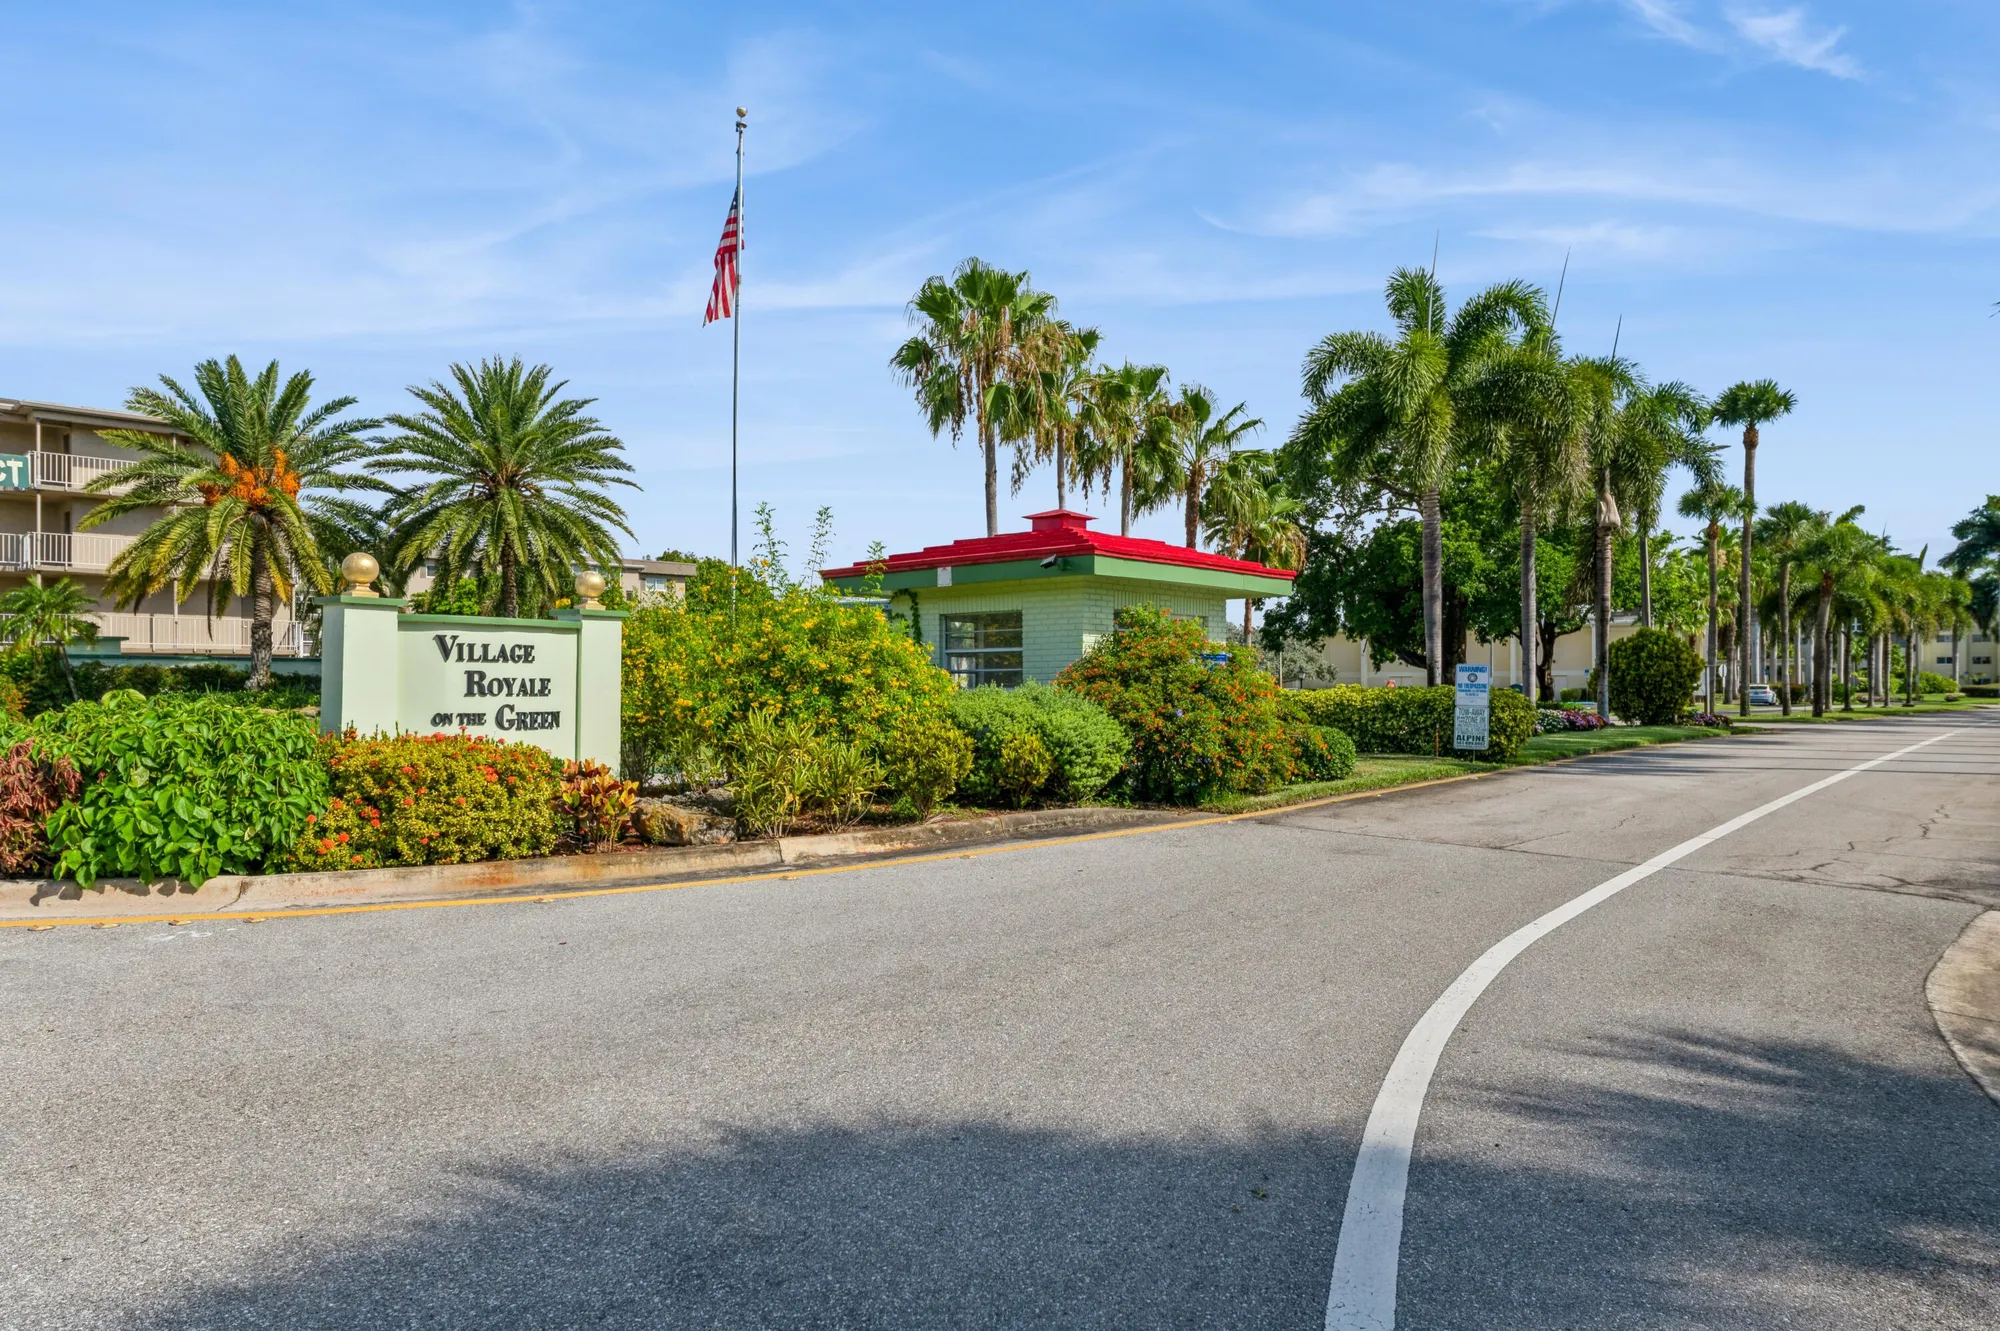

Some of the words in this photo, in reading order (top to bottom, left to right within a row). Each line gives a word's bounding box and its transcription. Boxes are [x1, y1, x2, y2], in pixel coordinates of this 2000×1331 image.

[432, 634, 535, 664] VILLAGE
[463, 670, 551, 697] ROYALE
[430, 712, 454, 727] ON
[455, 712, 487, 726] THE
[495, 704, 561, 731] GREEN
